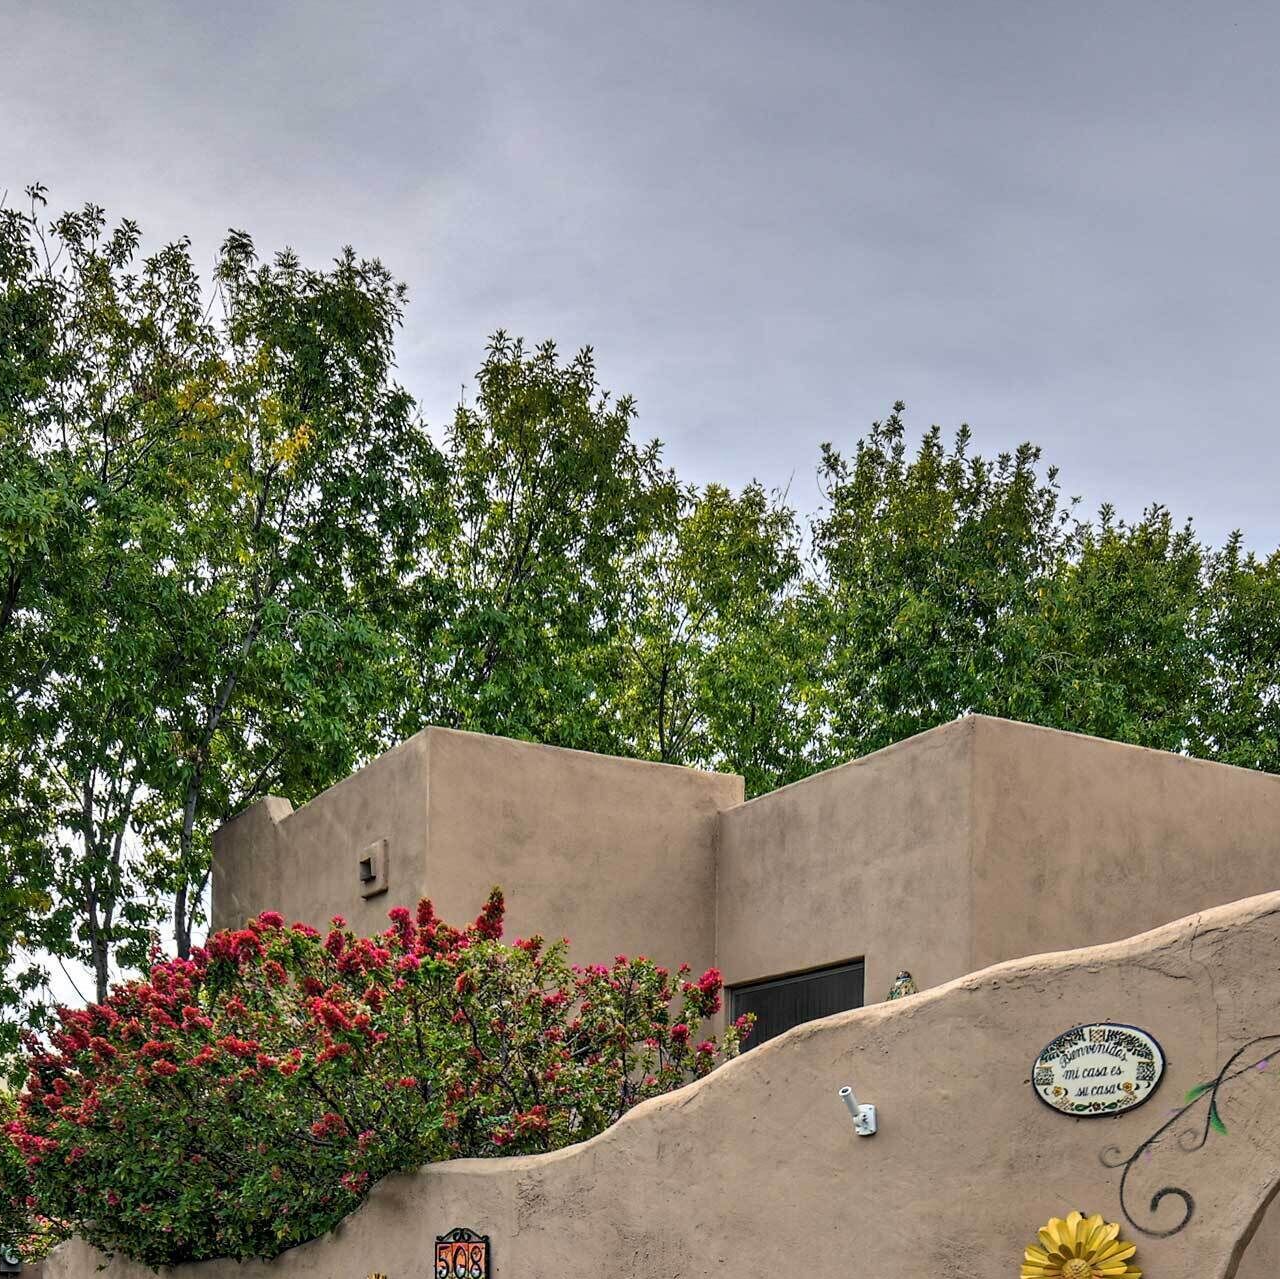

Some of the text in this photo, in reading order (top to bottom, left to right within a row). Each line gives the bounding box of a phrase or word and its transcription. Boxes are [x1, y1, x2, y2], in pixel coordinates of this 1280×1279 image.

[1062, 1065, 1123, 1079] mi casa es
[1075, 1084, 1116, 1097] su casa
[438, 1245, 482, 1279] 508
